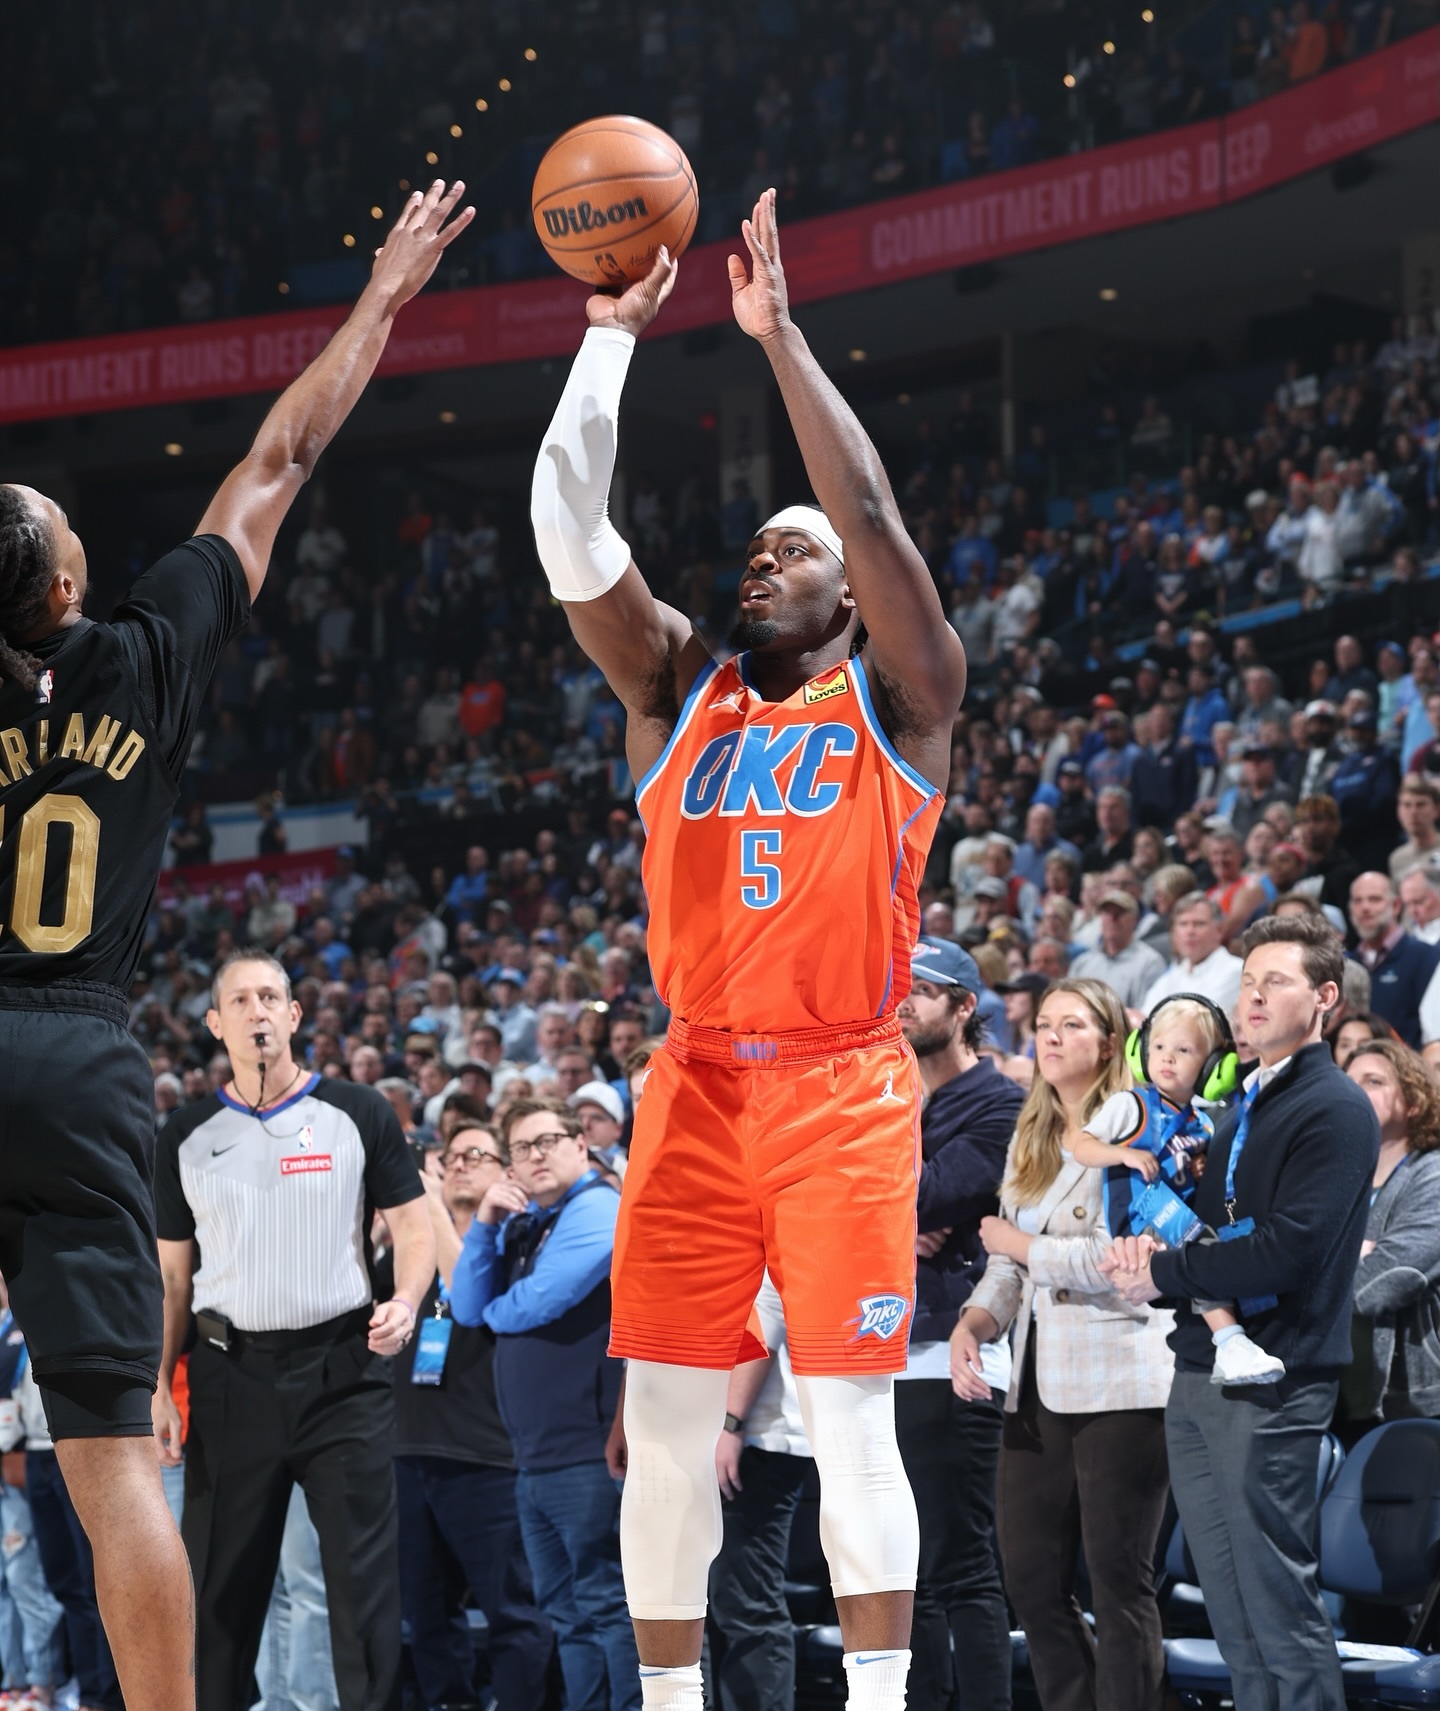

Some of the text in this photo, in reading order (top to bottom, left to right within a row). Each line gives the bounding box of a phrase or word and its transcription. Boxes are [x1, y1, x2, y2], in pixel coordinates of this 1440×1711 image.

[542, 196, 649, 238] Wilson
[872, 121, 1272, 271] COMMITMENT RUNS DEEP
[160, 335, 247, 388] RUNS
[0, 712, 145, 787] RLAND
[680, 722, 857, 820] OKC
[0, 793, 100, 953] 0
[741, 830, 782, 909] 5
[733, 1041, 777, 1060] THUNDER
[282, 1158, 331, 1172] Emirates
[860, 1303, 899, 1331] OKC
